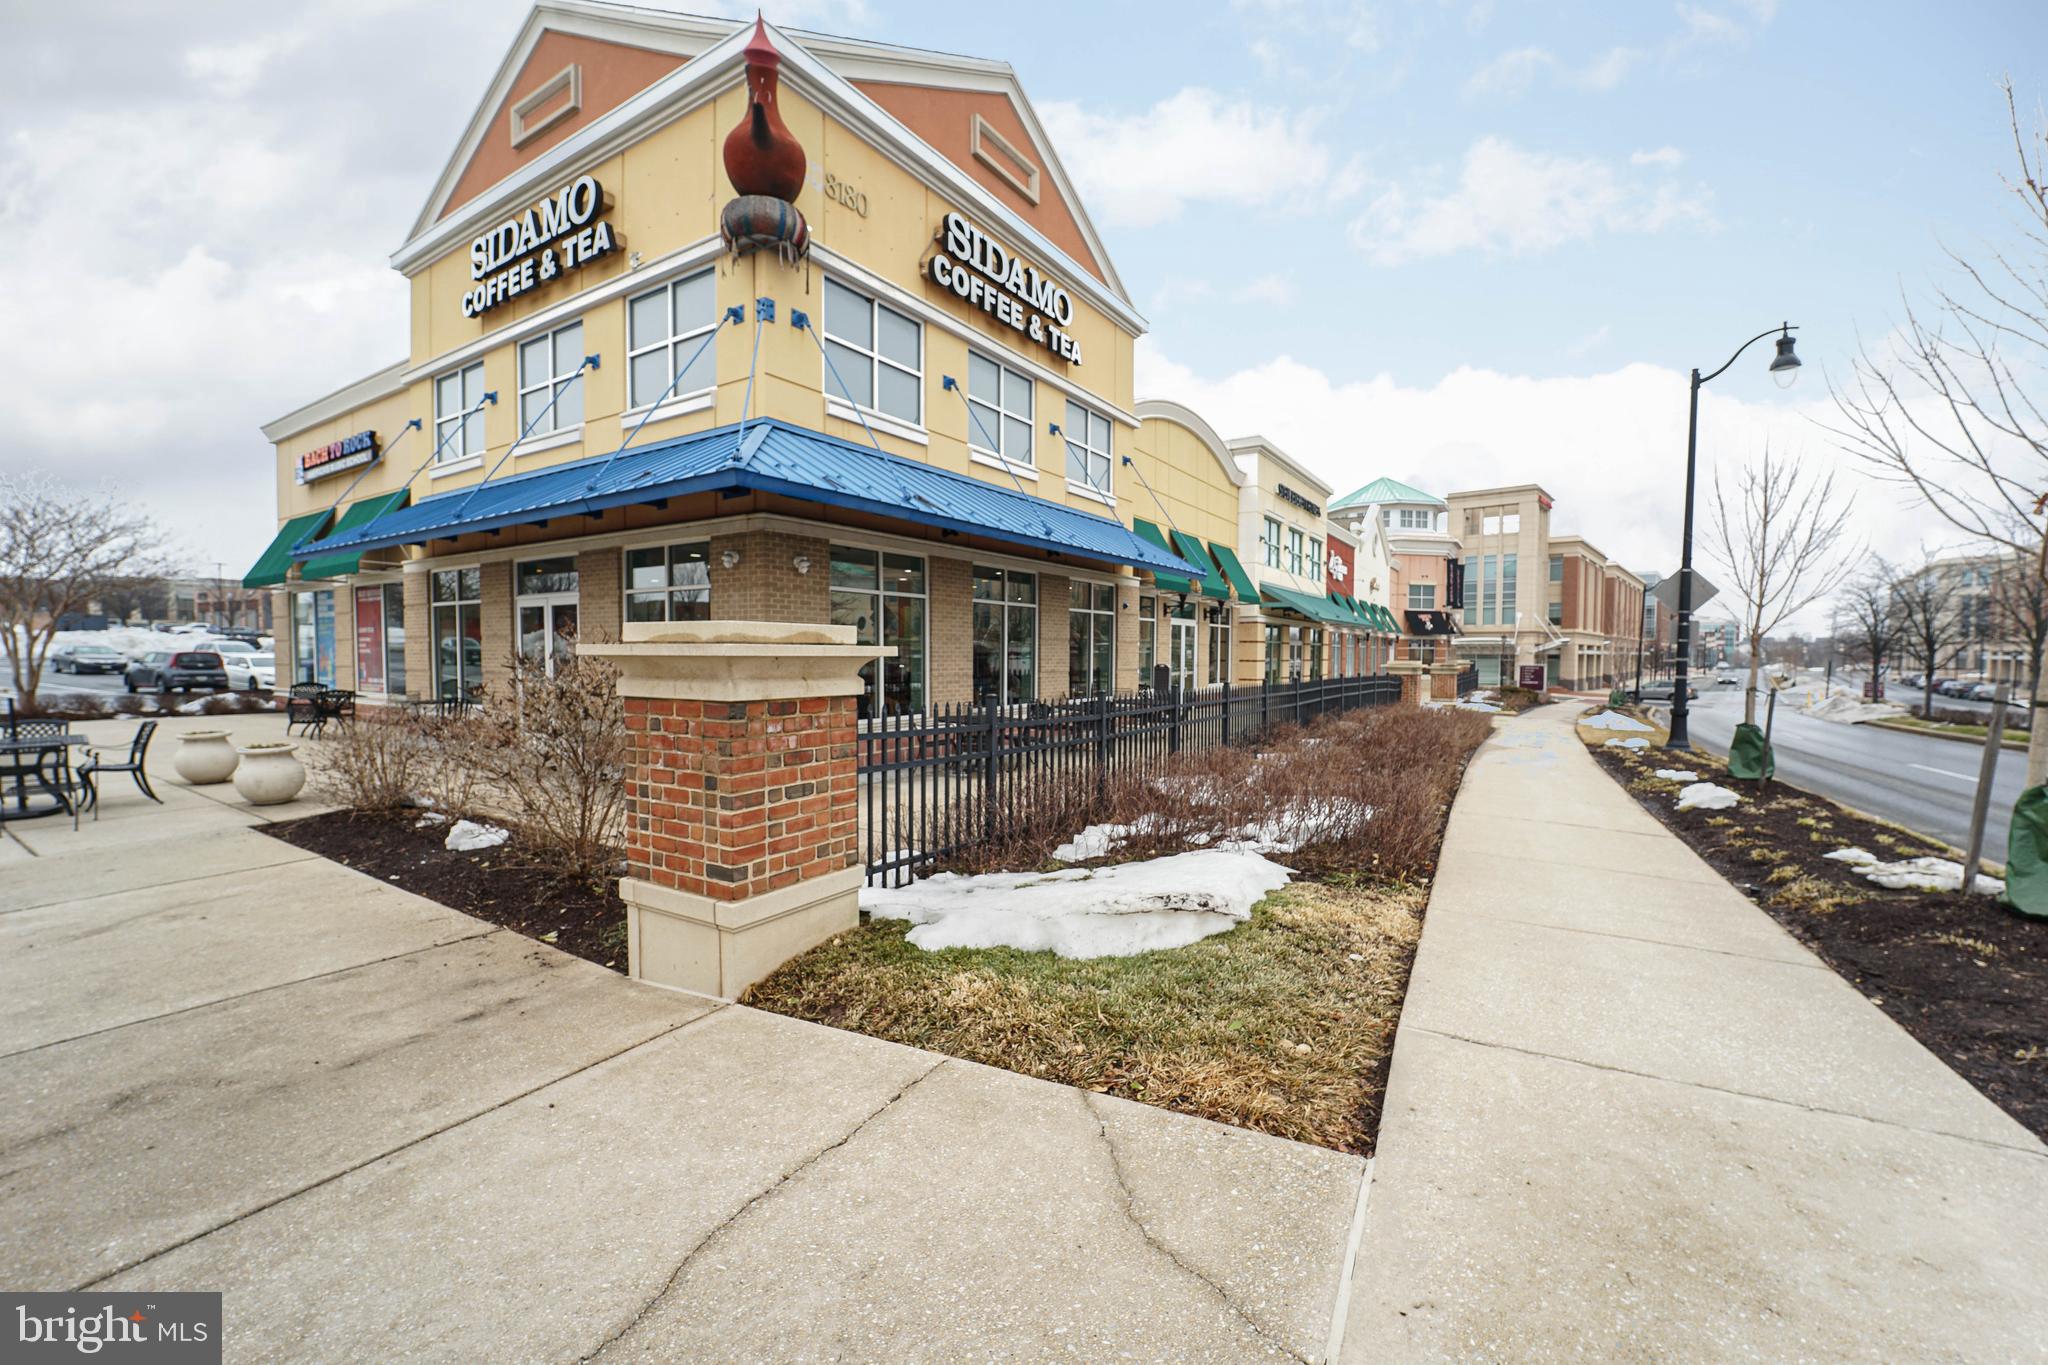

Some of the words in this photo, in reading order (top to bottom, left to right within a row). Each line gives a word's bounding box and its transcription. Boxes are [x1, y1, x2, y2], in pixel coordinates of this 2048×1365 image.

[470, 175, 597, 280] SIDAMO
[824, 172, 868, 219] 8180
[461, 258, 534, 318] COFFEE
[539, 248, 556, 280] &
[562, 221, 611, 268] TEA
[933, 254, 1024, 331] COFFEE
[1027, 313, 1044, 343] &
[1048, 324, 1082, 365] TEA
[946, 211, 1073, 326] SIDAMO
[329, 440, 342, 460] TO
[342, 431, 372, 455] ROCK
